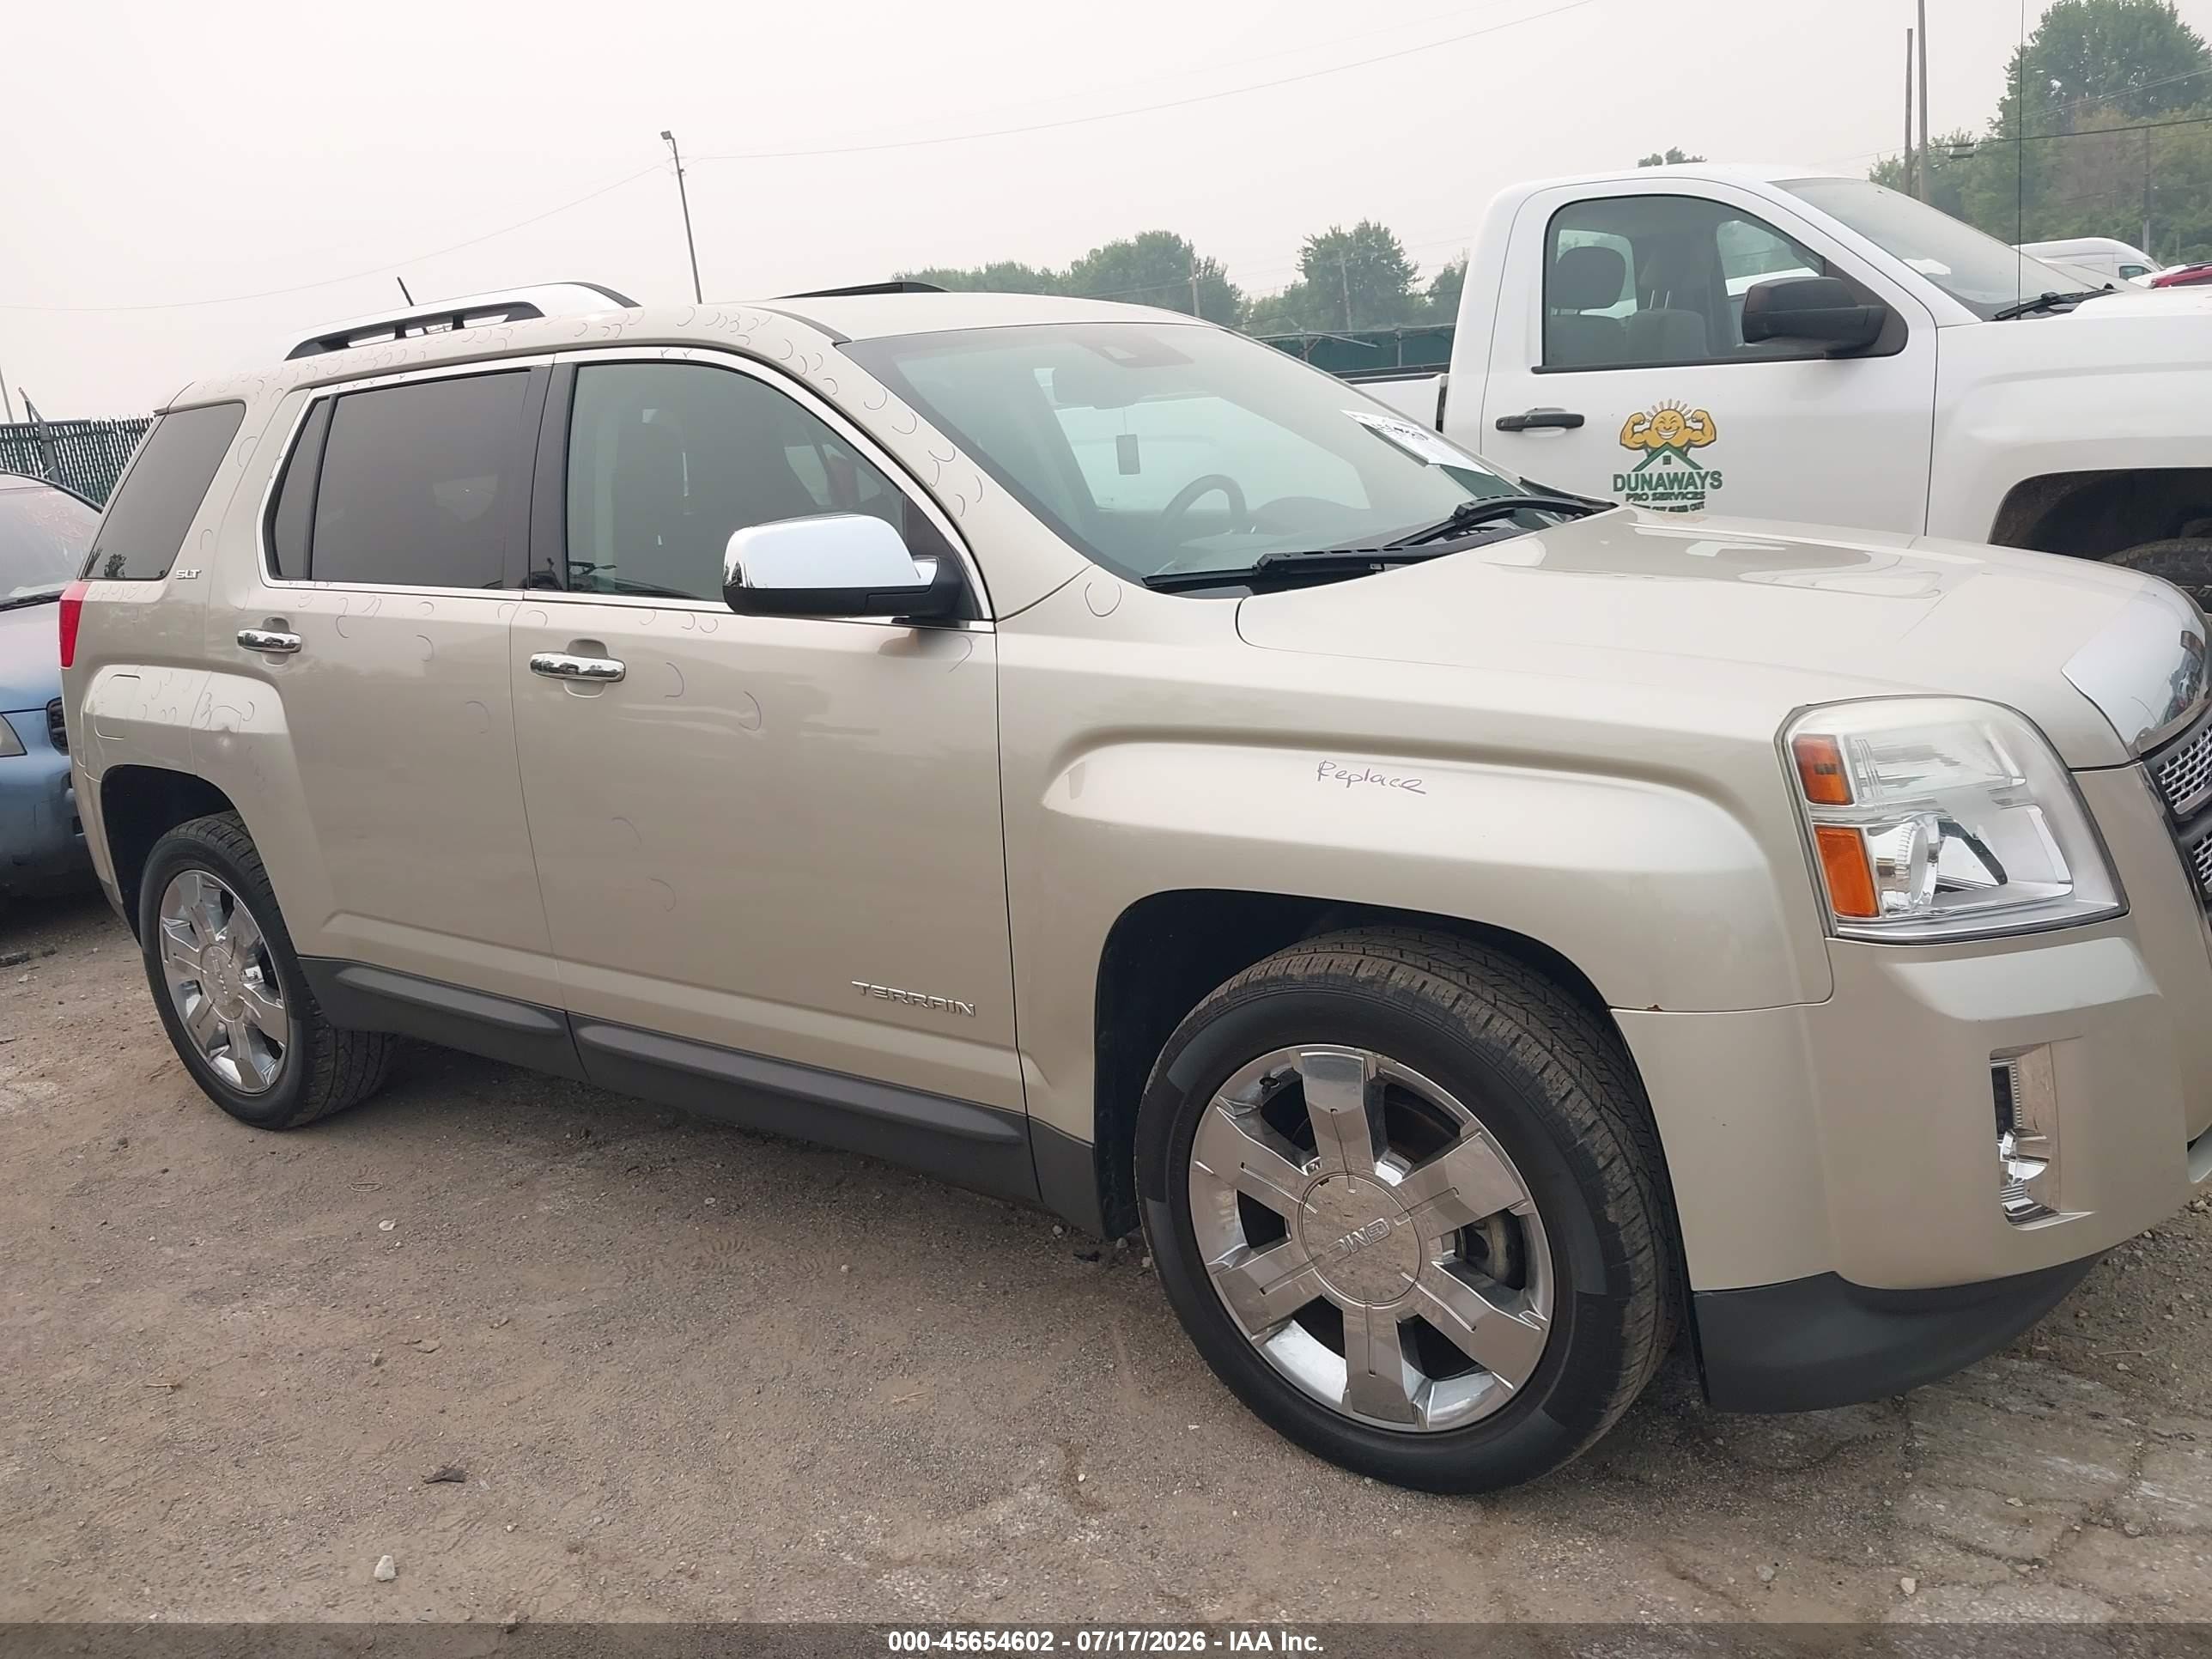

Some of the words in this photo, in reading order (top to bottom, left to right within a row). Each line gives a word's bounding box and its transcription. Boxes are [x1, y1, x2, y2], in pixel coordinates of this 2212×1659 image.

[1613, 471, 1723, 492] DUNAWAYS
[1626, 492, 1650, 502] PRO
[1651, 490, 1706, 501] SERVICES
[175, 569, 202, 580] SLT
[1317, 760, 1427, 794] Replace
[851, 981, 975, 1017] TERRAIN
[1328, 1218, 1392, 1262] GMC
